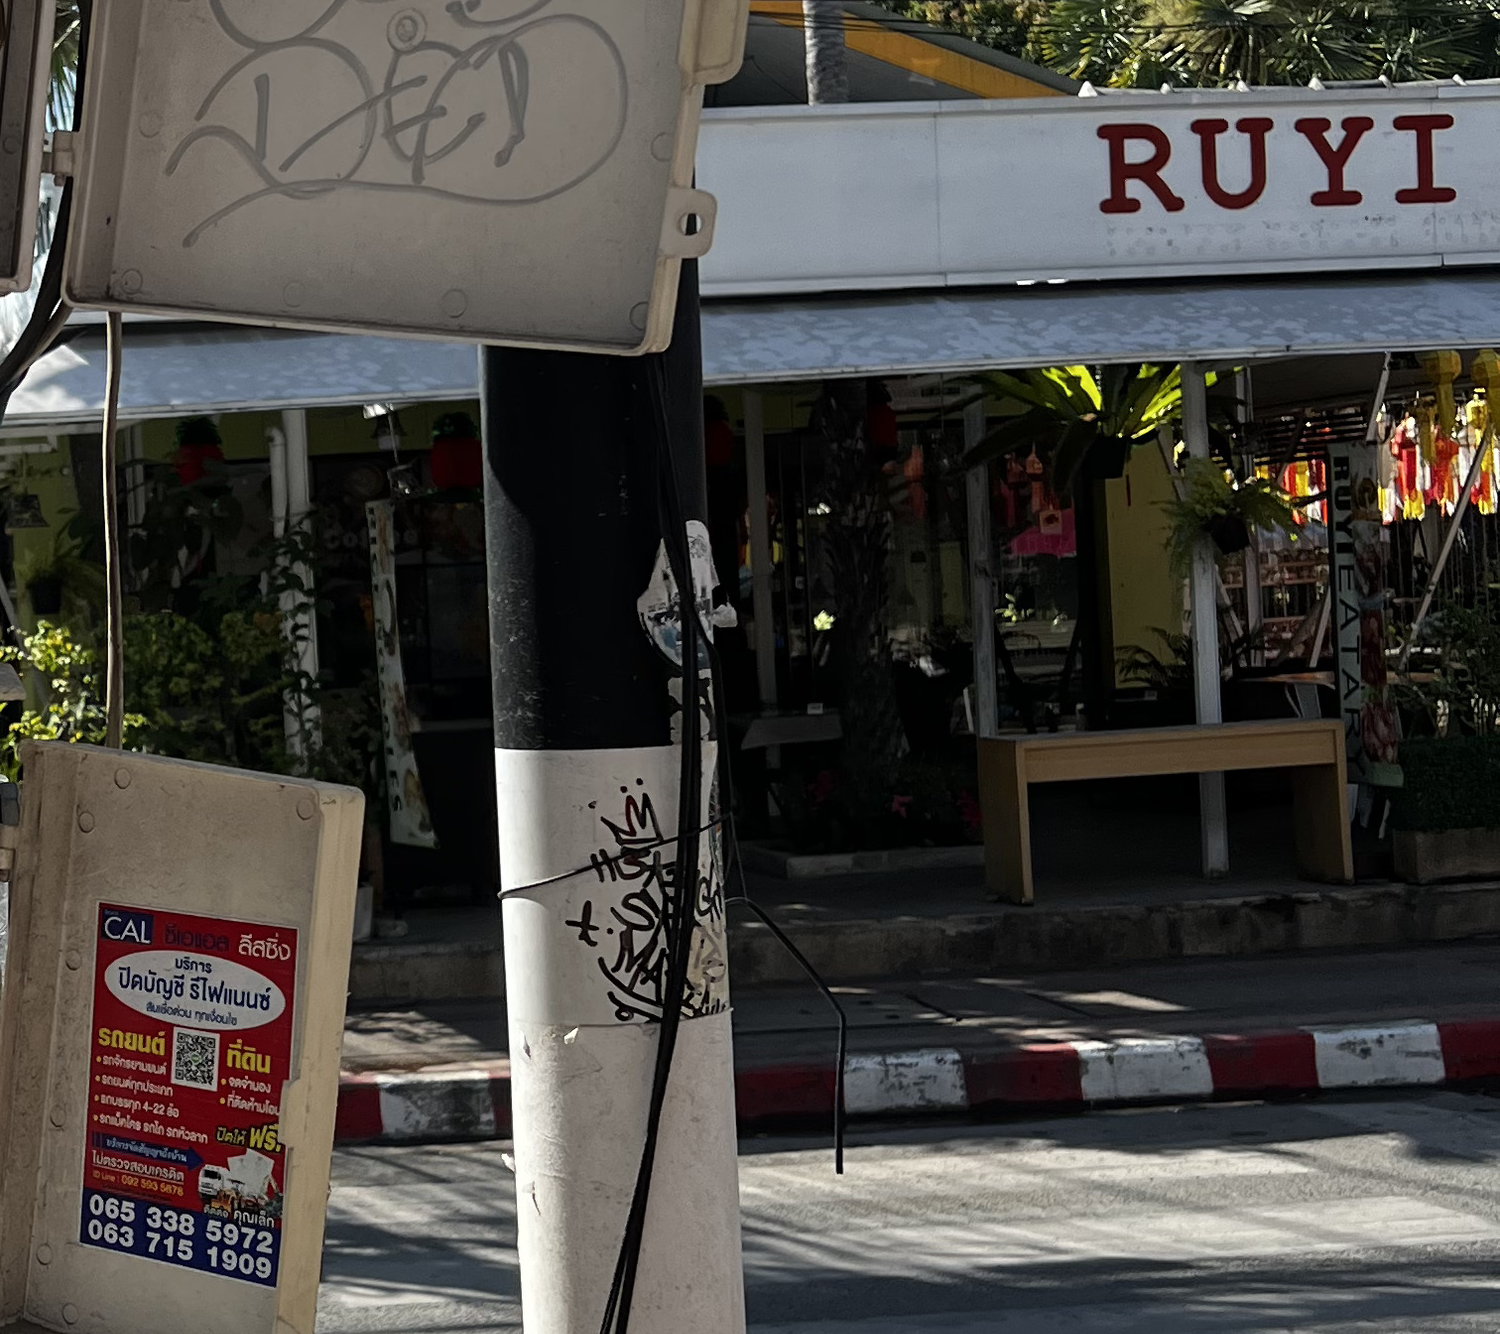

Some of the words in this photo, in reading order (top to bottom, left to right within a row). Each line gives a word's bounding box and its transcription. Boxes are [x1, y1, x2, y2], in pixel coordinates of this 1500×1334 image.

[1097, 114, 1456, 214] RUYI
[1333, 456, 1355, 554] RUYI
[104, 917, 150, 943] CAL
[239, 932, 290, 960] ลีสซิ่ง
[175, 955, 211, 973] บริการ
[117, 965, 184, 1002] ปิดบัญชี
[189, 975, 271, 1011] รีไฟแนนซ์
[98, 1028, 167, 1056] รถยนต์
[226, 1039, 271, 1074] ที่ดิน
[142, 1100, 165, 1115] 4-22
[89, 1195, 135, 1221] 065
[147, 1207, 194, 1235] 338
[206, 1220, 273, 1254] 5972
[88, 1220, 134, 1247] 063
[146, 1232, 193, 1260] 715
[207, 1247, 271, 1278] 1909
